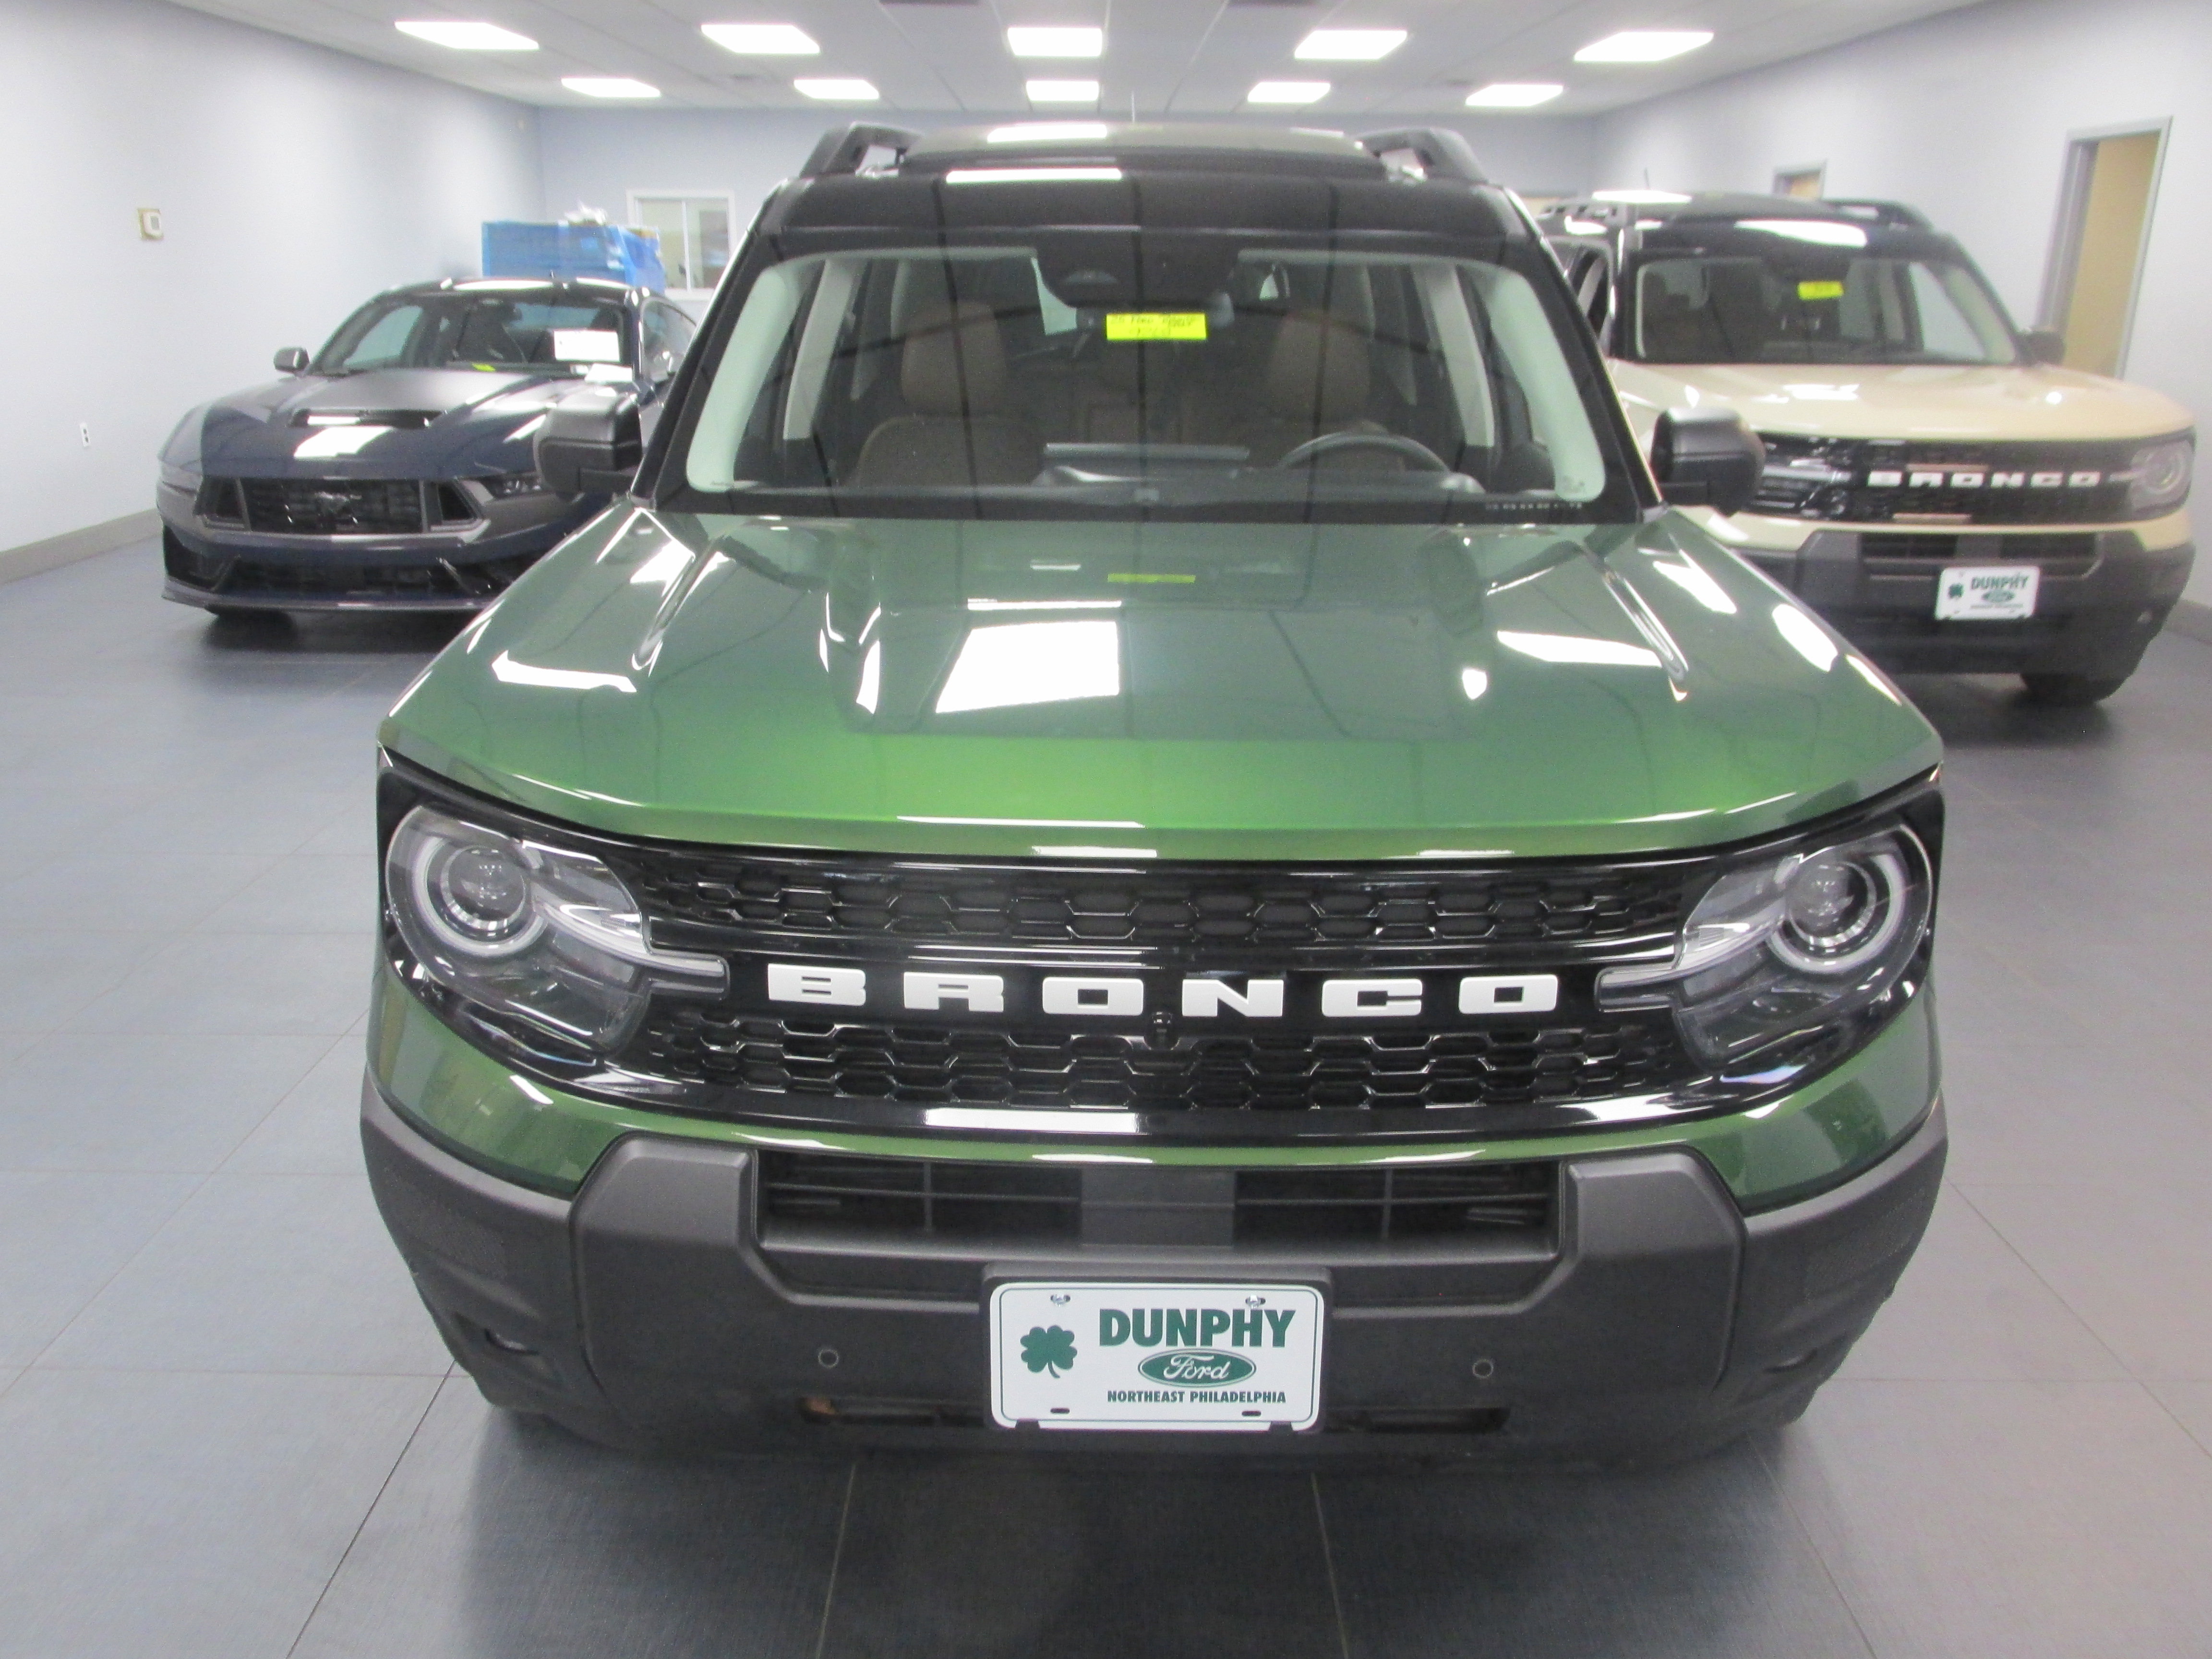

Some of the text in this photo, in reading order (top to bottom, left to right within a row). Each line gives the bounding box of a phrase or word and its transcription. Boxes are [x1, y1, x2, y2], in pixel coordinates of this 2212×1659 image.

[1868, 469, 2101, 489] BRONCO
[1971, 574, 2029, 590] DUNPHY
[767, 962, 1559, 1018] BRONCO
[1099, 1309, 1295, 1347] DUNPHY
[1163, 1355, 1231, 1380] Ford
[1107, 1391, 1286, 1404] NORTHEAST PHILADELPHIA
